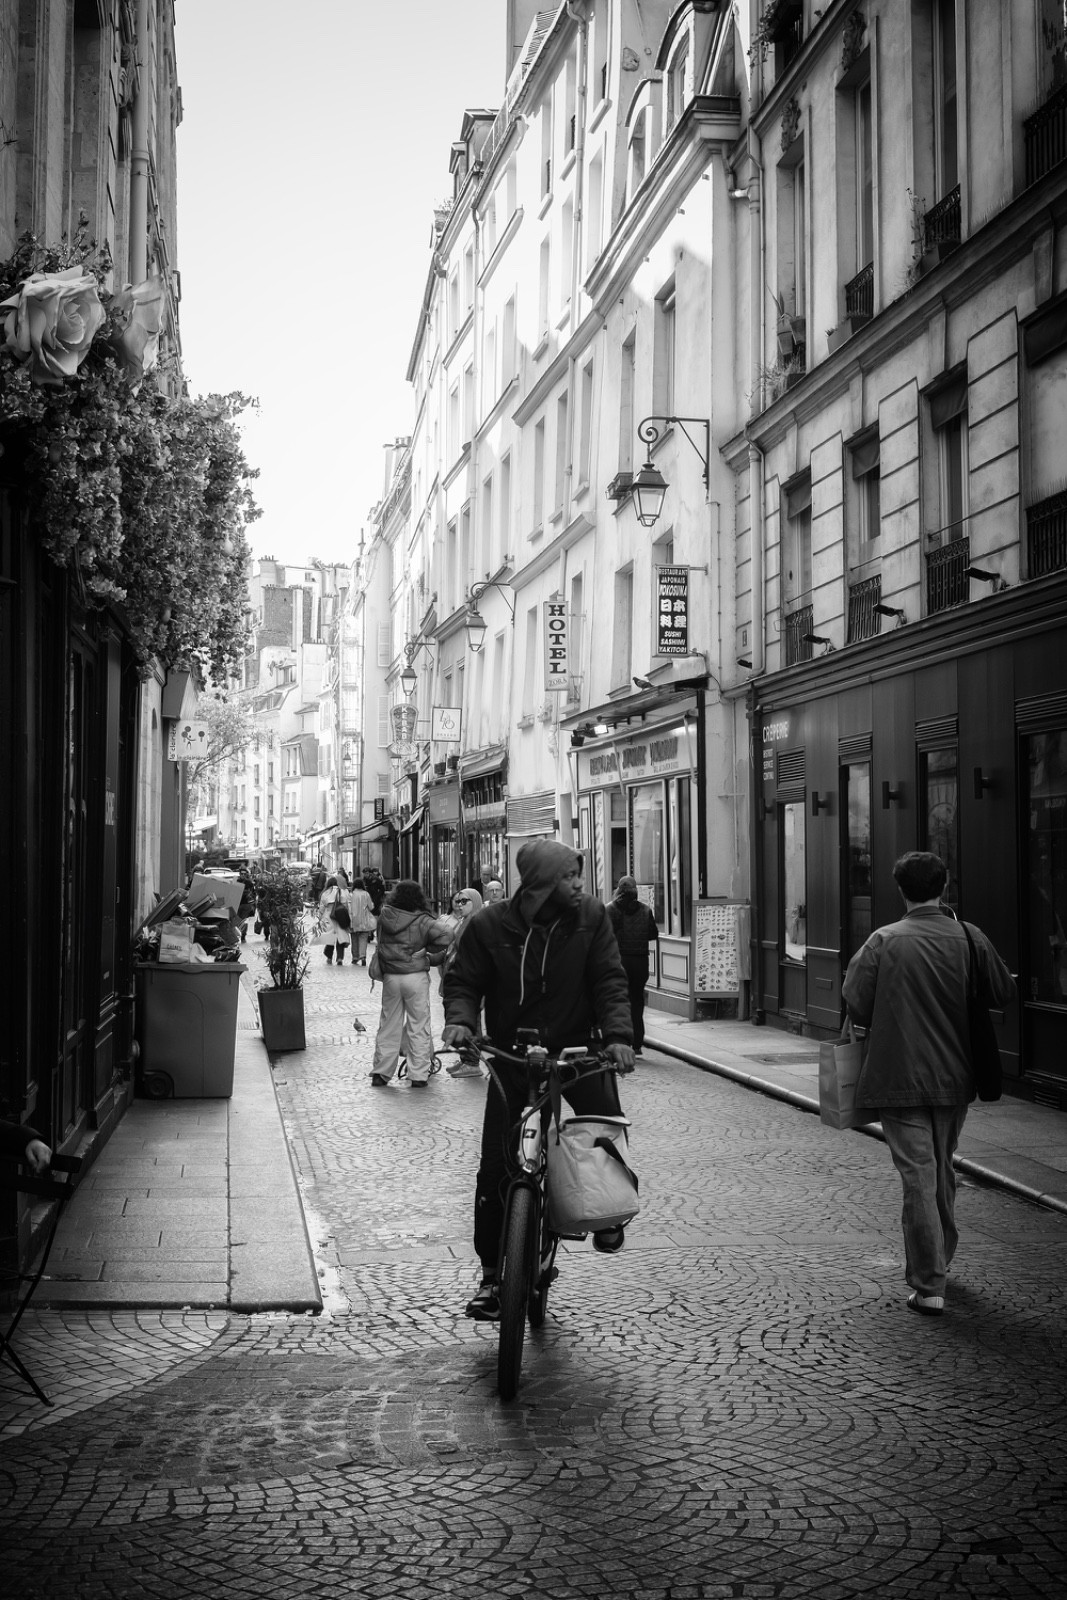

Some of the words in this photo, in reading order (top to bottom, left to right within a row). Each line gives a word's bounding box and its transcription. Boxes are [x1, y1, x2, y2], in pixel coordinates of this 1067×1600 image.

[661, 576, 686, 584] JAPONAIS
[660, 598, 686, 613] 日本
[664, 630, 683, 638] SUSHI
[548, 604, 567, 674] HOTEL
[660, 638, 686, 646] SASHIMI
